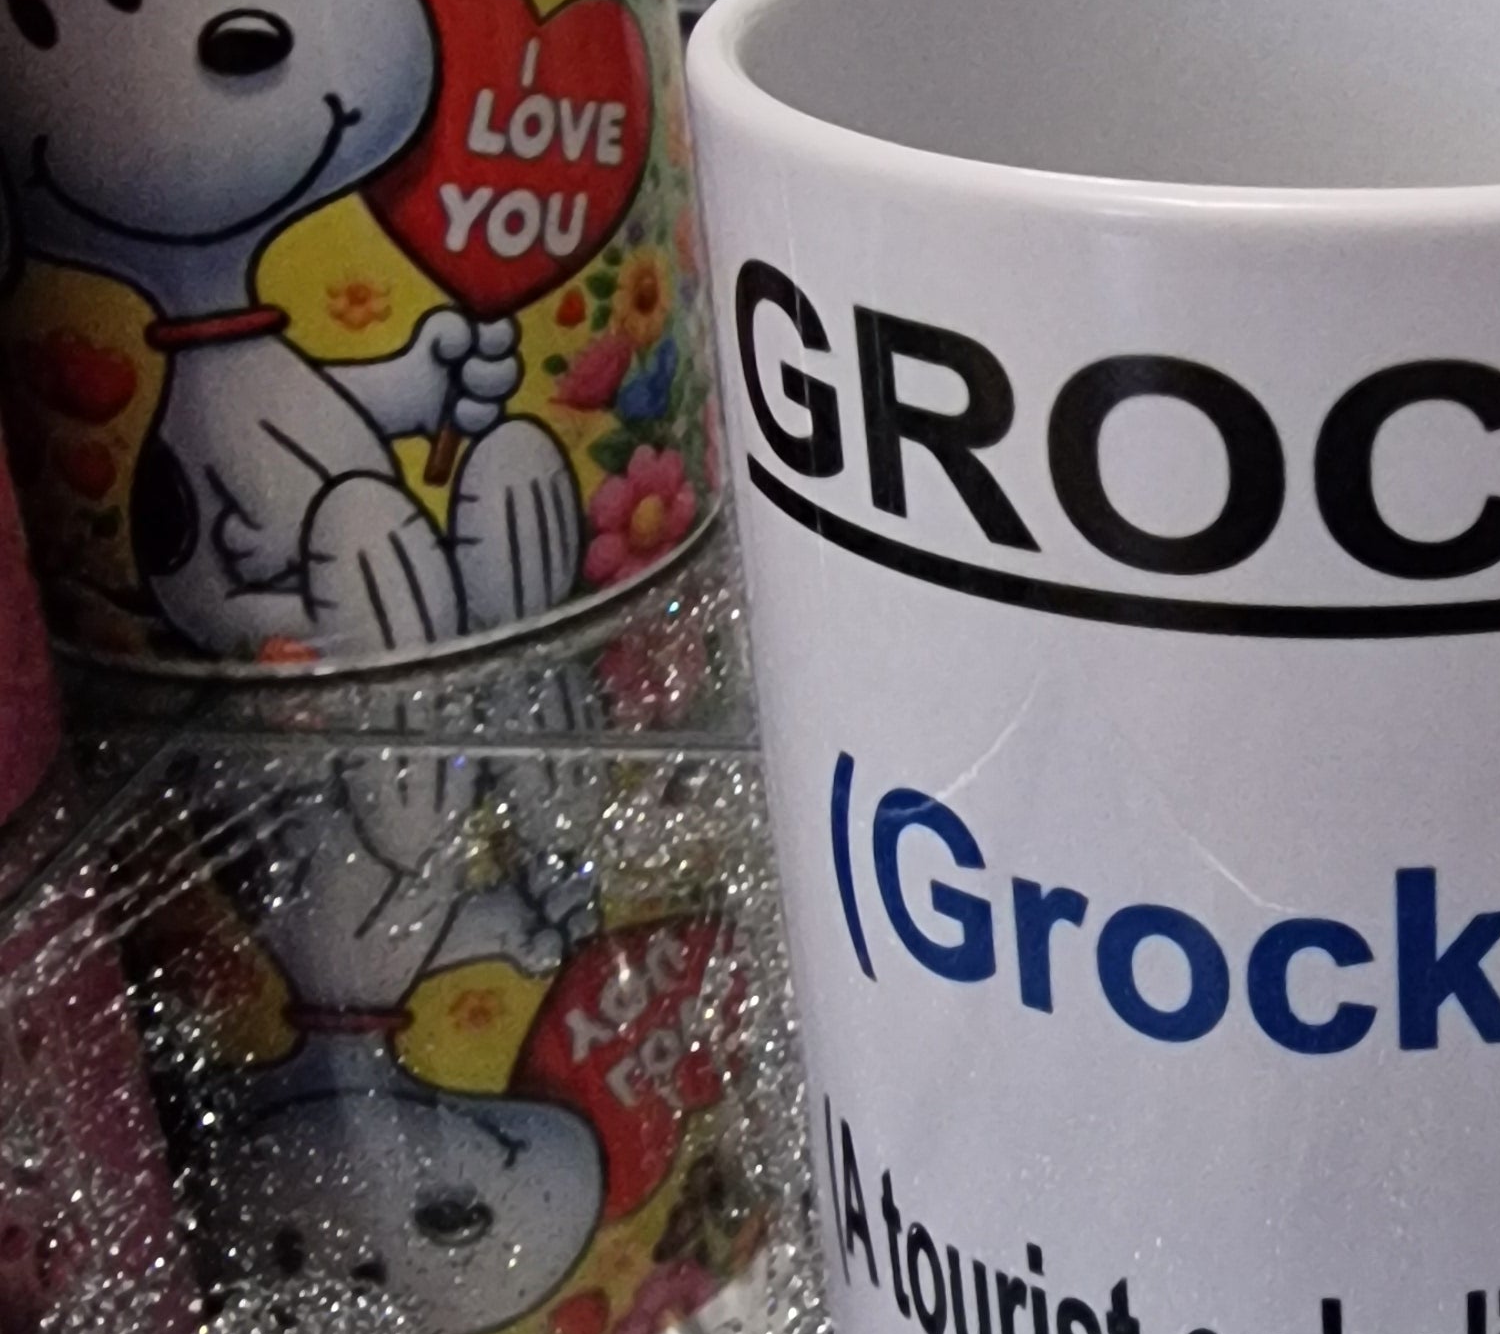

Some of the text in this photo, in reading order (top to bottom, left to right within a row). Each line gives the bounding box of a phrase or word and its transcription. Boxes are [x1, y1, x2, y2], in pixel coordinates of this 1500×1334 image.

[521, 36, 540, 87] I
[467, 88, 627, 165] LOVE
[439, 182, 588, 259] YOU
